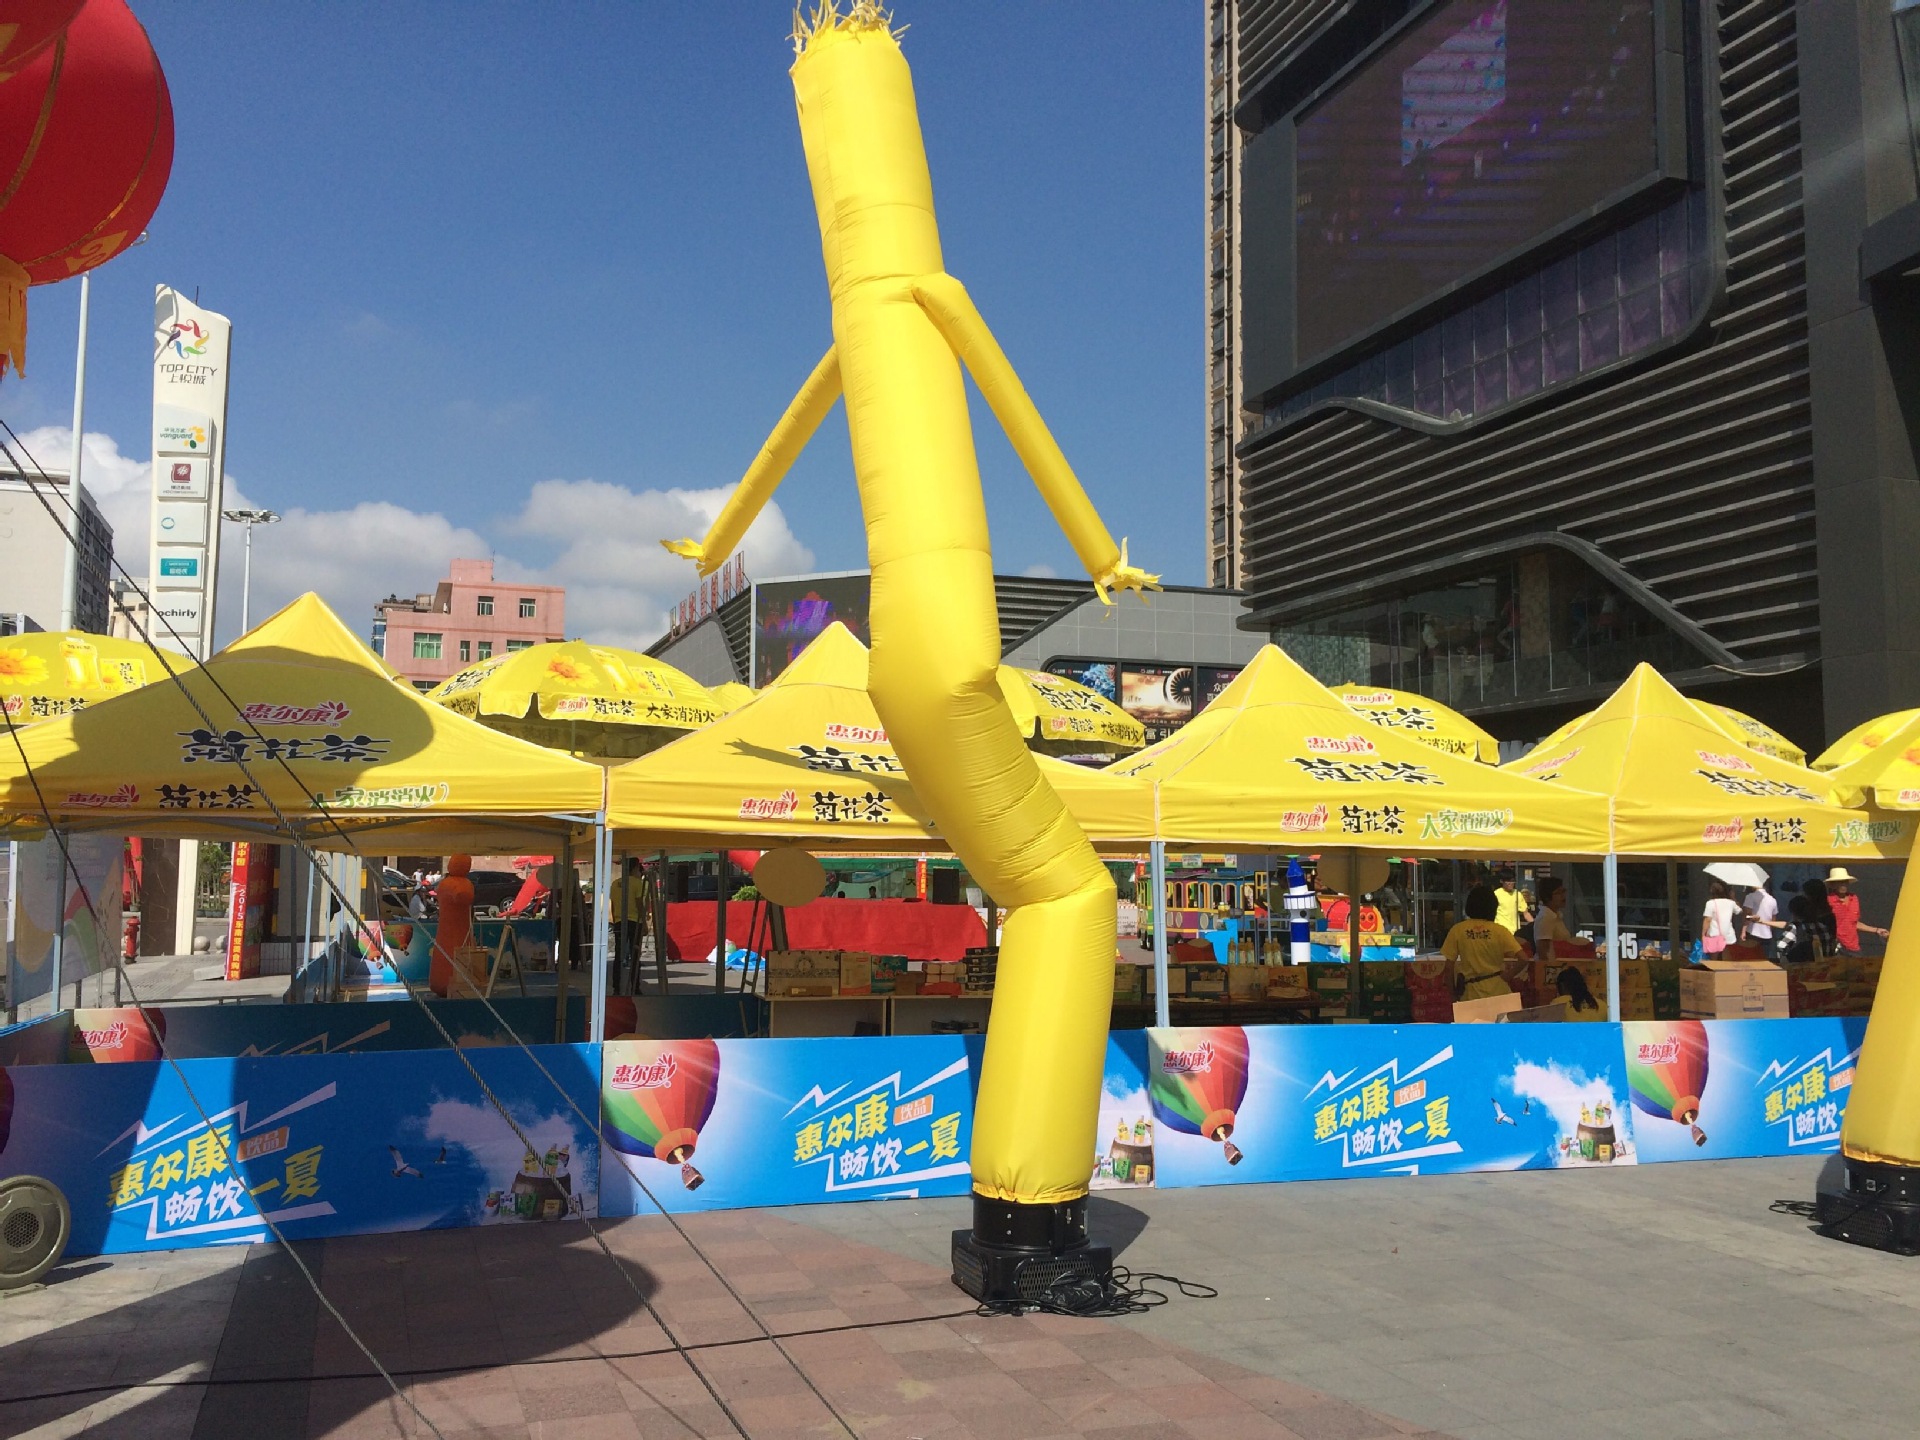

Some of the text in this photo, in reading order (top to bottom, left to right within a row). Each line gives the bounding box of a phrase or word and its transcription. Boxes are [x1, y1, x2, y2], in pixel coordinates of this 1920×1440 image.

[160, 364, 218, 376] TOP CITY
[157, 609, 197, 618] ochirly
[29, 696, 89, 716] 菊花茶
[243, 703, 333, 725] 惠尔康
[594, 697, 635, 717] 菊花茶
[646, 703, 715, 723] 大家消消火
[1351, 705, 1435, 730] 花茶
[177, 729, 391, 762] 菊花茶
[788, 745, 905, 772] 菊花
[1287, 758, 1445, 785] 菊花茶
[741, 791, 892, 823] 惠尔康 菊花茶
[1281, 805, 1505, 839] 惠尔康 菊花茶 大家消消火
[1753, 818, 1807, 843] 菊花茶
[1830, 820, 1900, 848] 大家消消火
[1619, 932, 1638, 960] 15
[1163, 1050, 1208, 1071] 惠尔康
[1638, 1044, 1674, 1063] 惠尔康
[612, 1064, 667, 1088] 惠尔康
[1765, 1064, 1826, 1122] 惠尔康
[1314, 1075, 1422, 1140] 惠尔康 饮品
[1796, 1100, 1846, 1137] 畅饮
[793, 1091, 928, 1162] 惠尔康 饮品
[106, 1123, 281, 1207] 惠尔康 饮品
